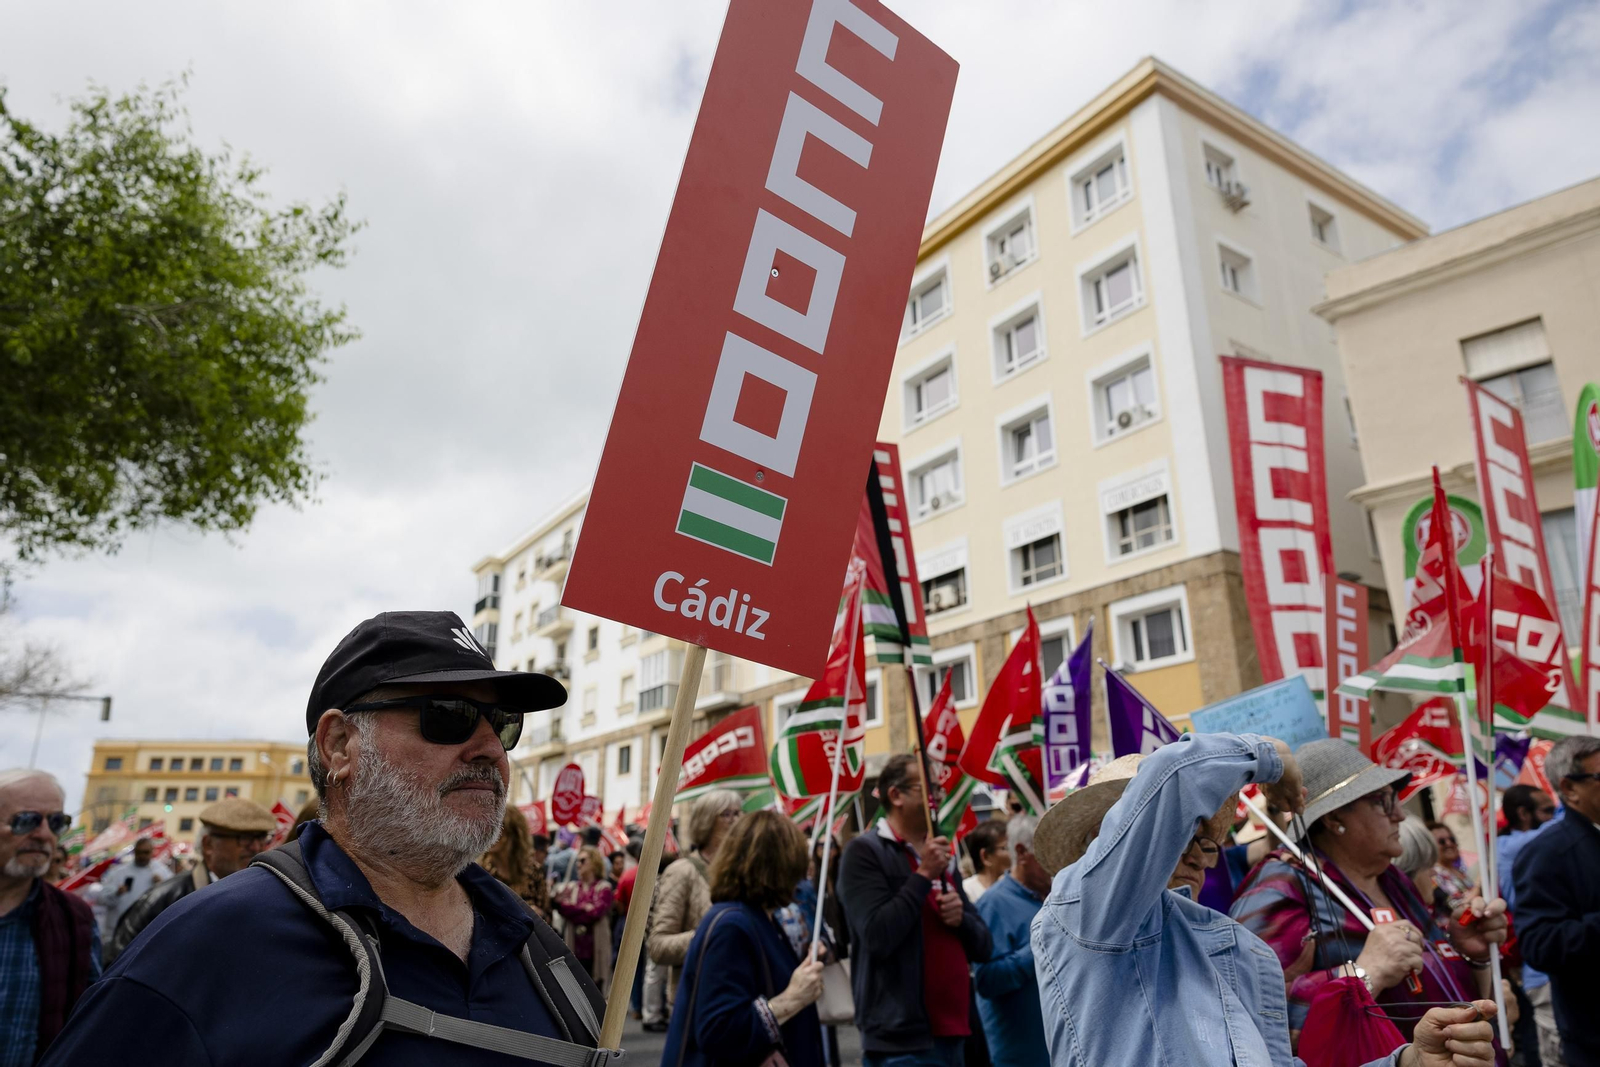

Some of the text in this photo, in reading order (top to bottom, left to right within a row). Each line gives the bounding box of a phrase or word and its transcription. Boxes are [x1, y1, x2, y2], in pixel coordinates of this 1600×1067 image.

[699, 0, 899, 478] CCOO
[653, 570, 771, 641] Cádiz
[1243, 366, 1326, 694] CCOO
[1335, 583, 1361, 724] CCOO
